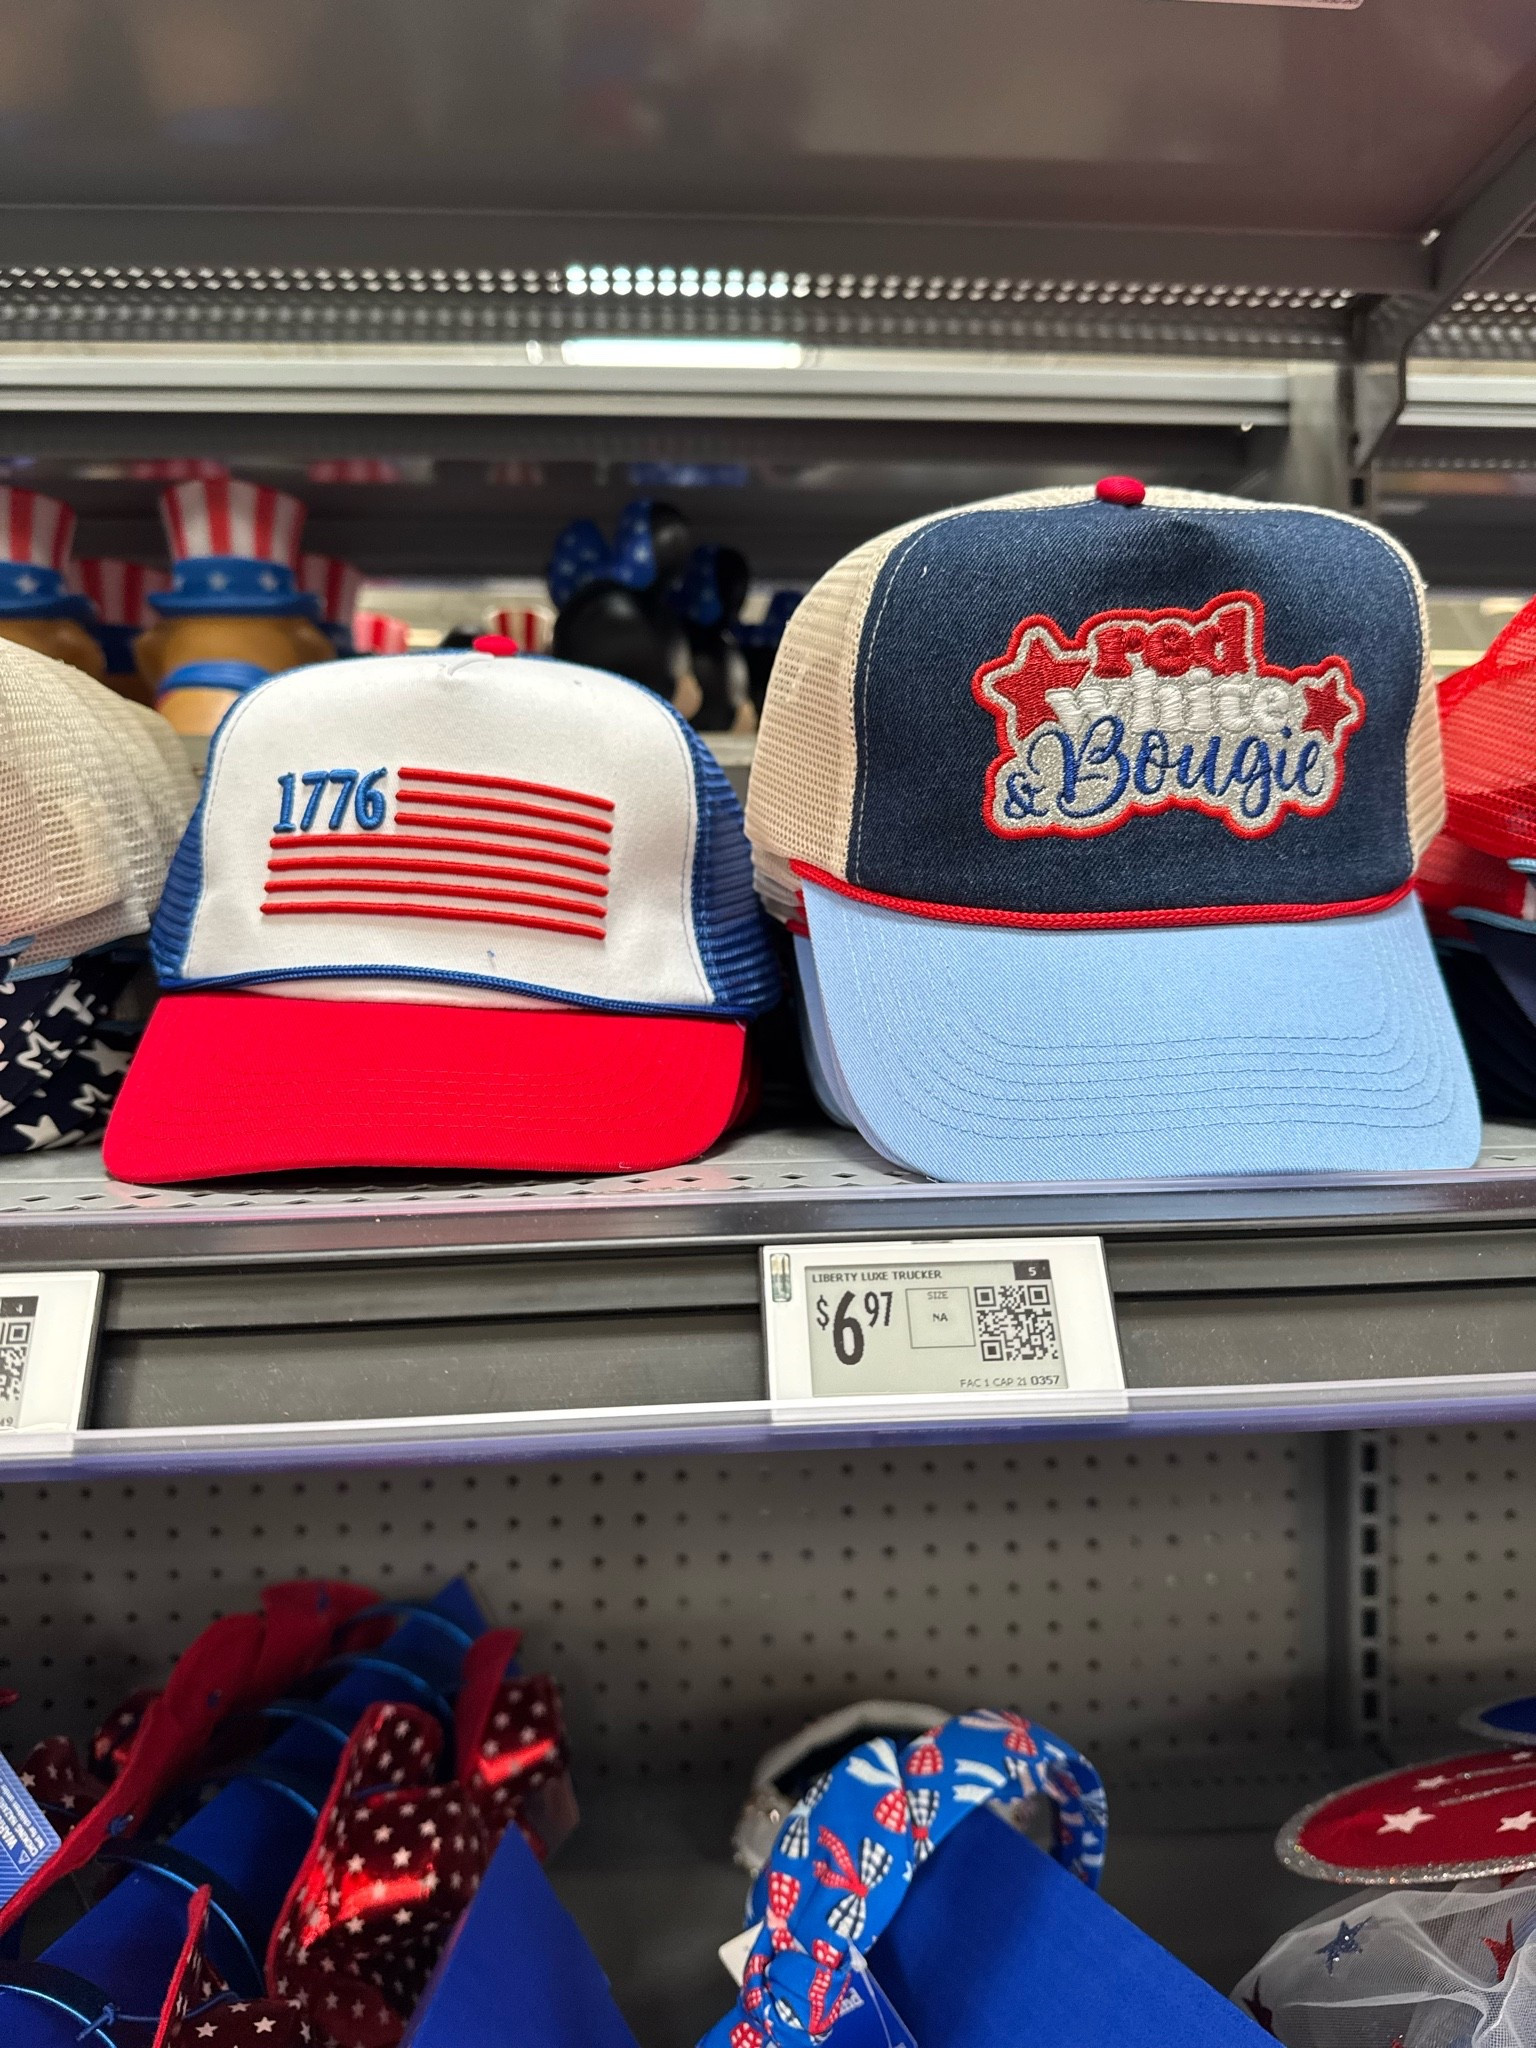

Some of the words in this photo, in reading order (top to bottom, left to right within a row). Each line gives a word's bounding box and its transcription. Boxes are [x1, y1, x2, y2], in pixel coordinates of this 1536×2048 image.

[1096, 607, 1249, 678] red
[1044, 668, 1290, 732] white
[1003, 771, 1049, 819] &
[1026, 715, 1325, 819] Bougie
[273, 766, 388, 833] 1776
[812, 1272, 857, 1283] LIBERTY
[861, 1271, 888, 1281] LUXE
[891, 1269, 942, 1280] TRUCKER
[1028, 1266, 1037, 1276] 5
[927, 1290, 949, 1300] SIZE
[932, 1313, 948, 1322] NA
[960, 1379, 981, 1388] FAC
[992, 1377, 1013, 1387] CAP
[1030, 1375, 1060, 1385] 0357
[12, 1801, 32, 1827] children
[27, 1825, 38, 1838] for
[34, 1834, 46, 1849] Not
